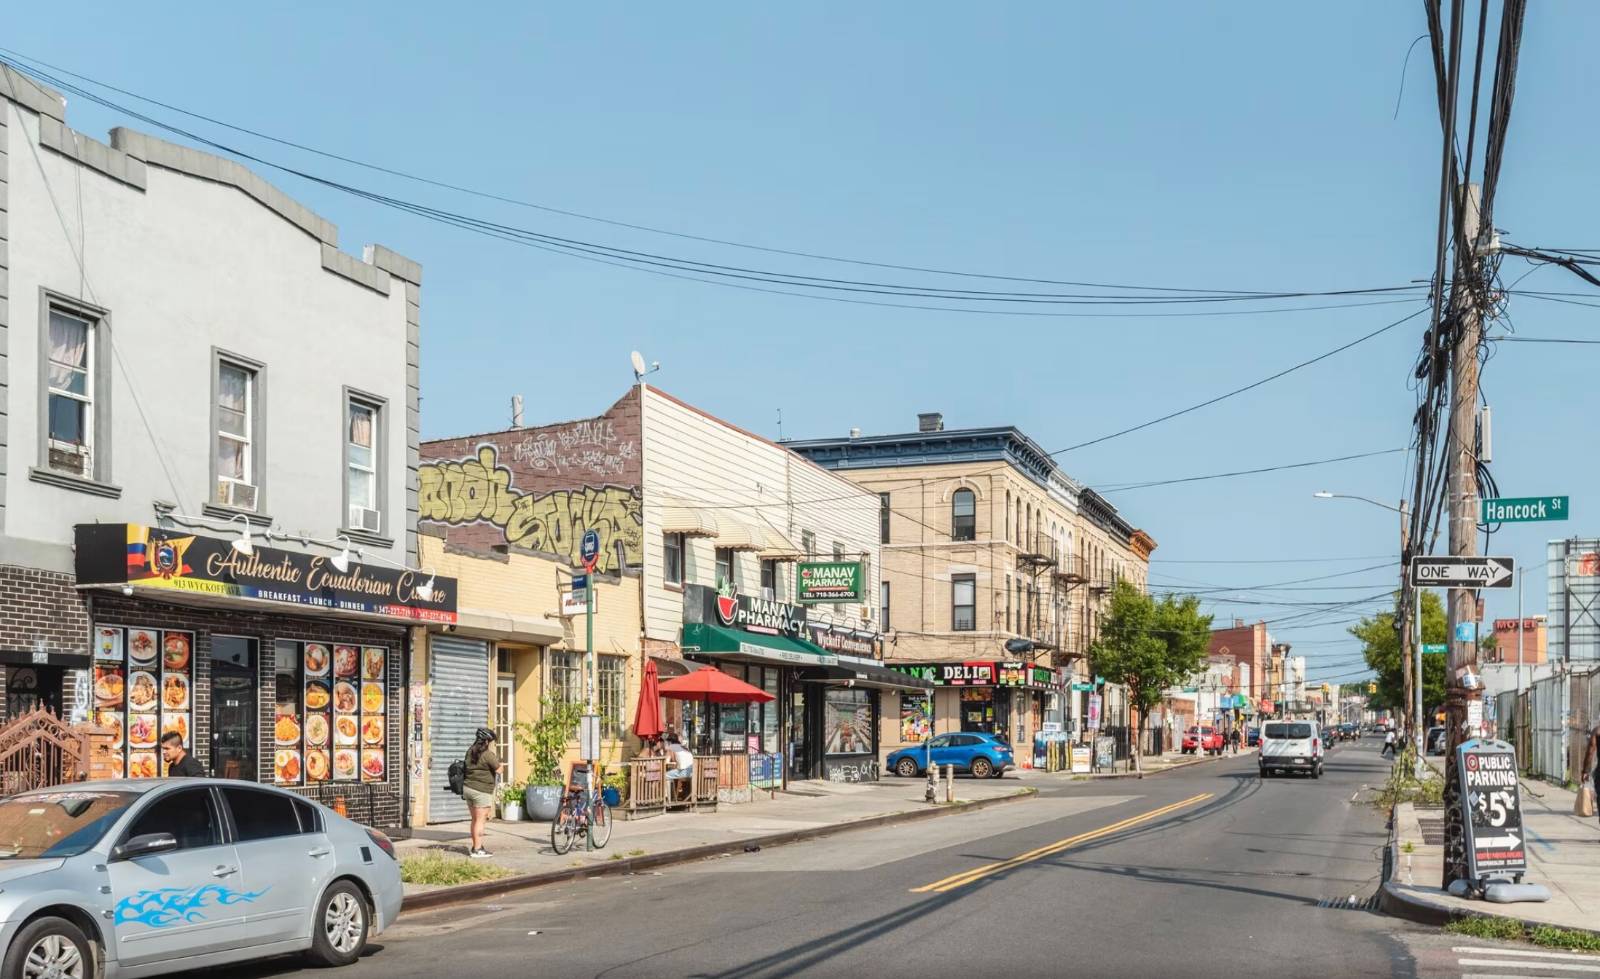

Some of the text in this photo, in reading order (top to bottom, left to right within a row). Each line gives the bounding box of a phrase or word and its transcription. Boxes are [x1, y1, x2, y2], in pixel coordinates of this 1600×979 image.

[1486, 498, 1561, 519] Hancock St
[206, 547, 302, 583] Authentic
[306, 556, 393, 596] Ecuadorian
[812, 567, 855, 579] MANAV
[1420, 566, 1500, 579] ONE WAY
[188, 581, 226, 594] WYCKOFF
[802, 578, 855, 588] PHARMACY
[258, 590, 301, 603] BREAKFAST
[309, 596, 332, 607] LUNCH
[340, 600, 365, 611] DINNER
[750, 597, 794, 617] MANAV
[738, 609, 805, 633] PHARMACY
[1496, 620, 1537, 629] MOEL
[816, 630, 841, 649] Wyckoff
[943, 666, 979, 680] DELI
[1479, 756, 1511, 769] PUBLIC
[1467, 771, 1517, 787] PARKING
